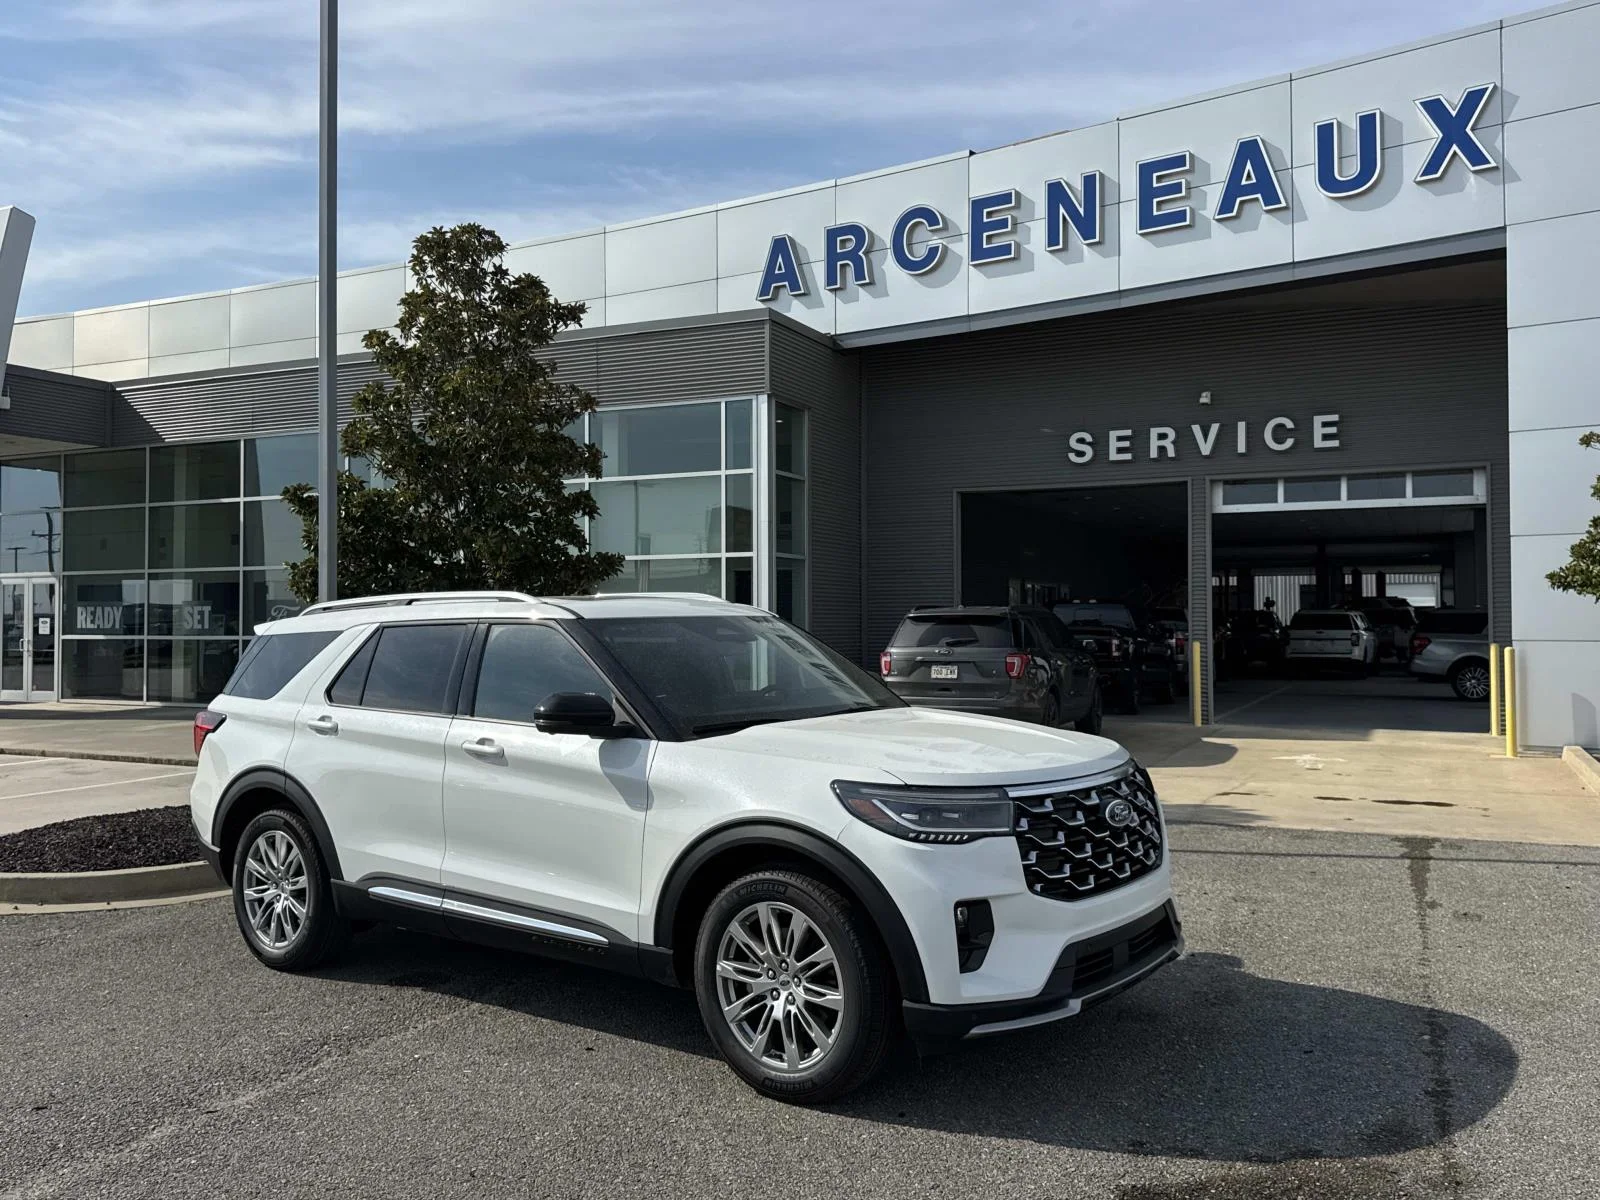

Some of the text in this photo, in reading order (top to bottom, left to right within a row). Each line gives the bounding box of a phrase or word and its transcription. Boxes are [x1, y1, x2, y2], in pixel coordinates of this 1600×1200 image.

[757, 82, 1499, 301] ARCENEAUX
[1067, 413, 1340, 464] SERVICE
[76, 605, 124, 630] READY
[184, 605, 212, 630] SET
